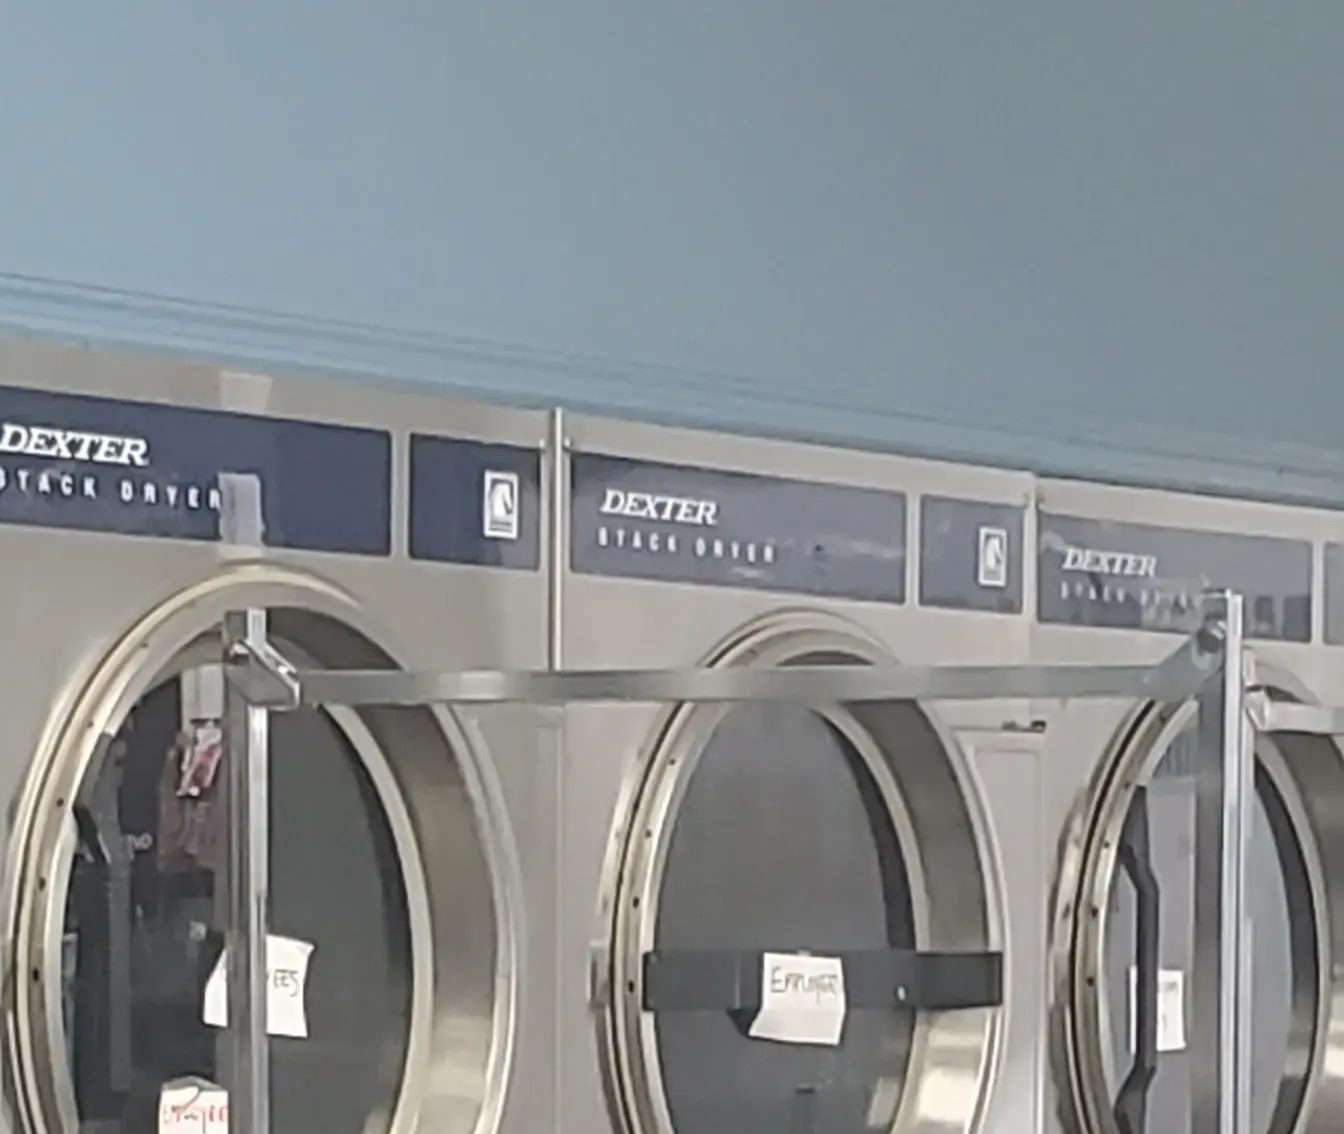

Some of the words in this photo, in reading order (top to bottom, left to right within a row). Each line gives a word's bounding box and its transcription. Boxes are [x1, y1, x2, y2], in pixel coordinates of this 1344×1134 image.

[120, 480, 221, 511] DRYER
[600, 488, 718, 526] DEXTER
[597, 526, 677, 553] STACK
[695, 536, 776, 565] DRYER
[1061, 546, 1156, 578] DEXTER
